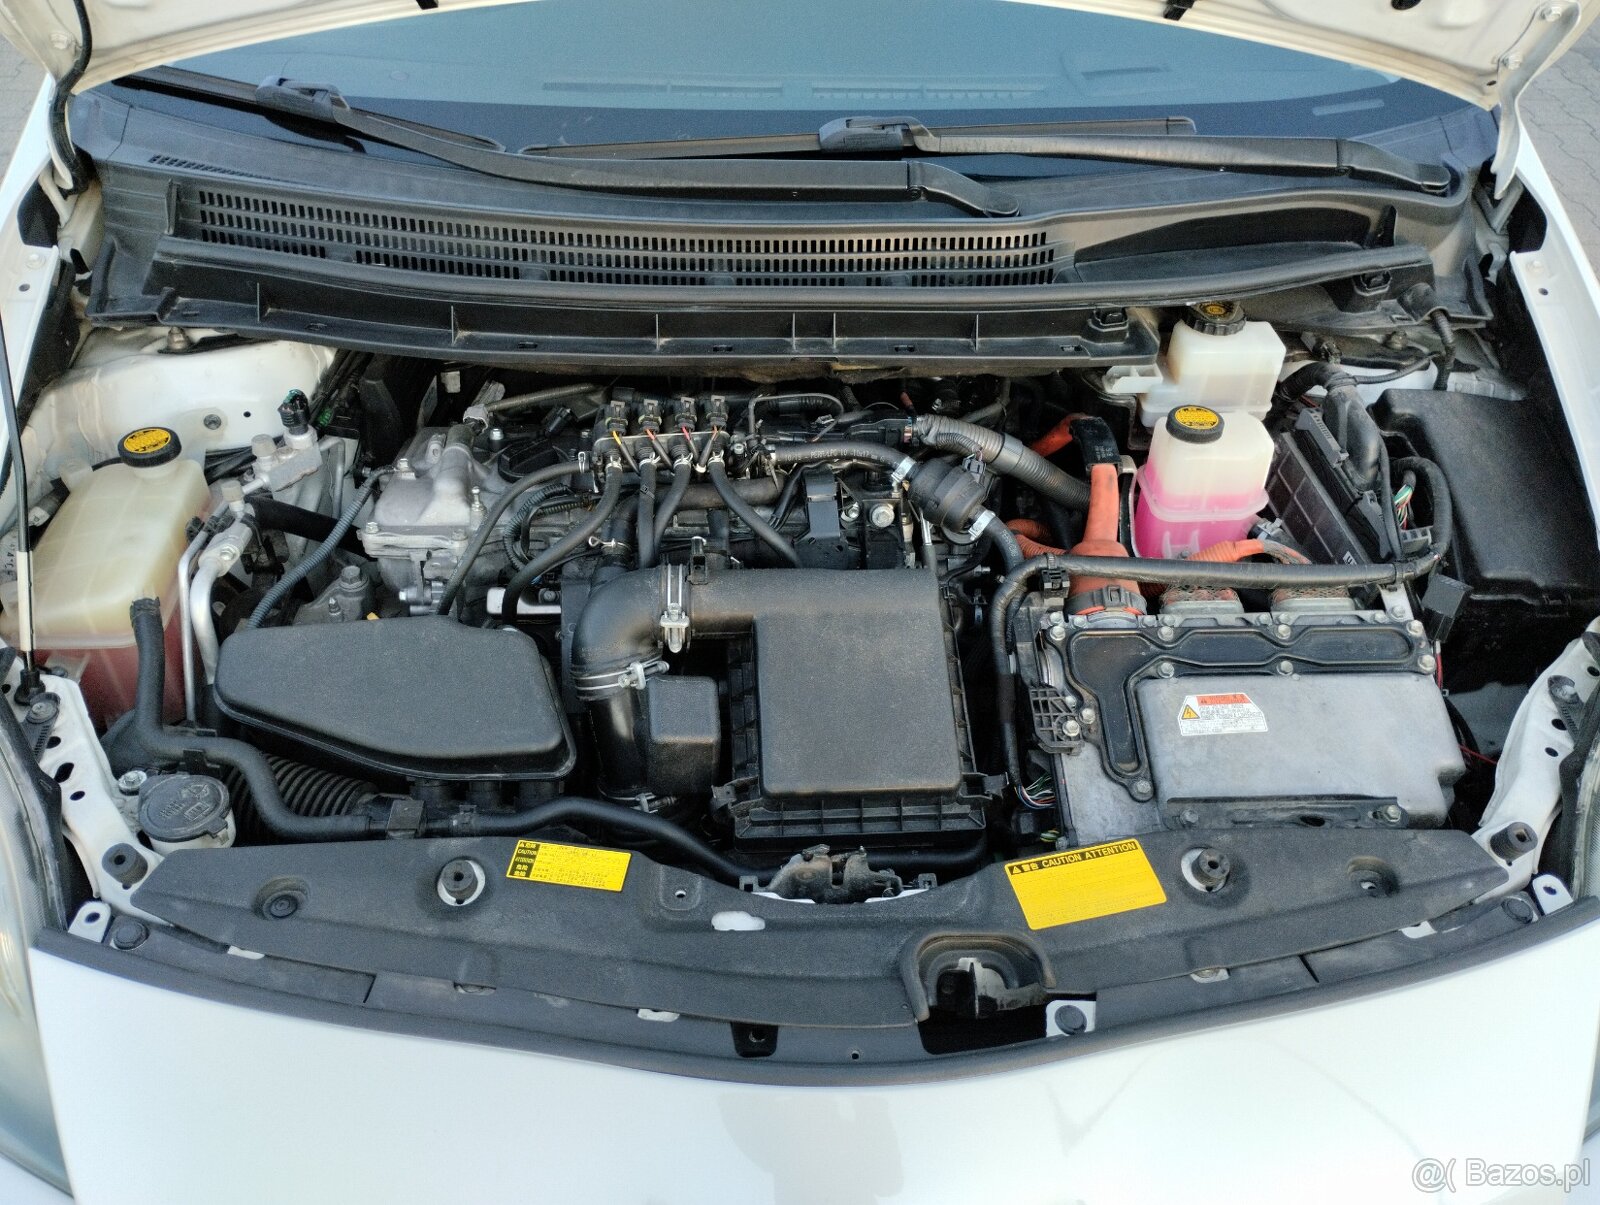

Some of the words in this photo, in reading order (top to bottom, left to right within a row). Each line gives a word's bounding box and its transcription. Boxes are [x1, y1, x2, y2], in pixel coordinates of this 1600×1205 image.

[517, 848, 537, 856] CAUTION
[1042, 853, 1082, 868] CAUTION
[1085, 842, 1137, 860] ATTENTION
